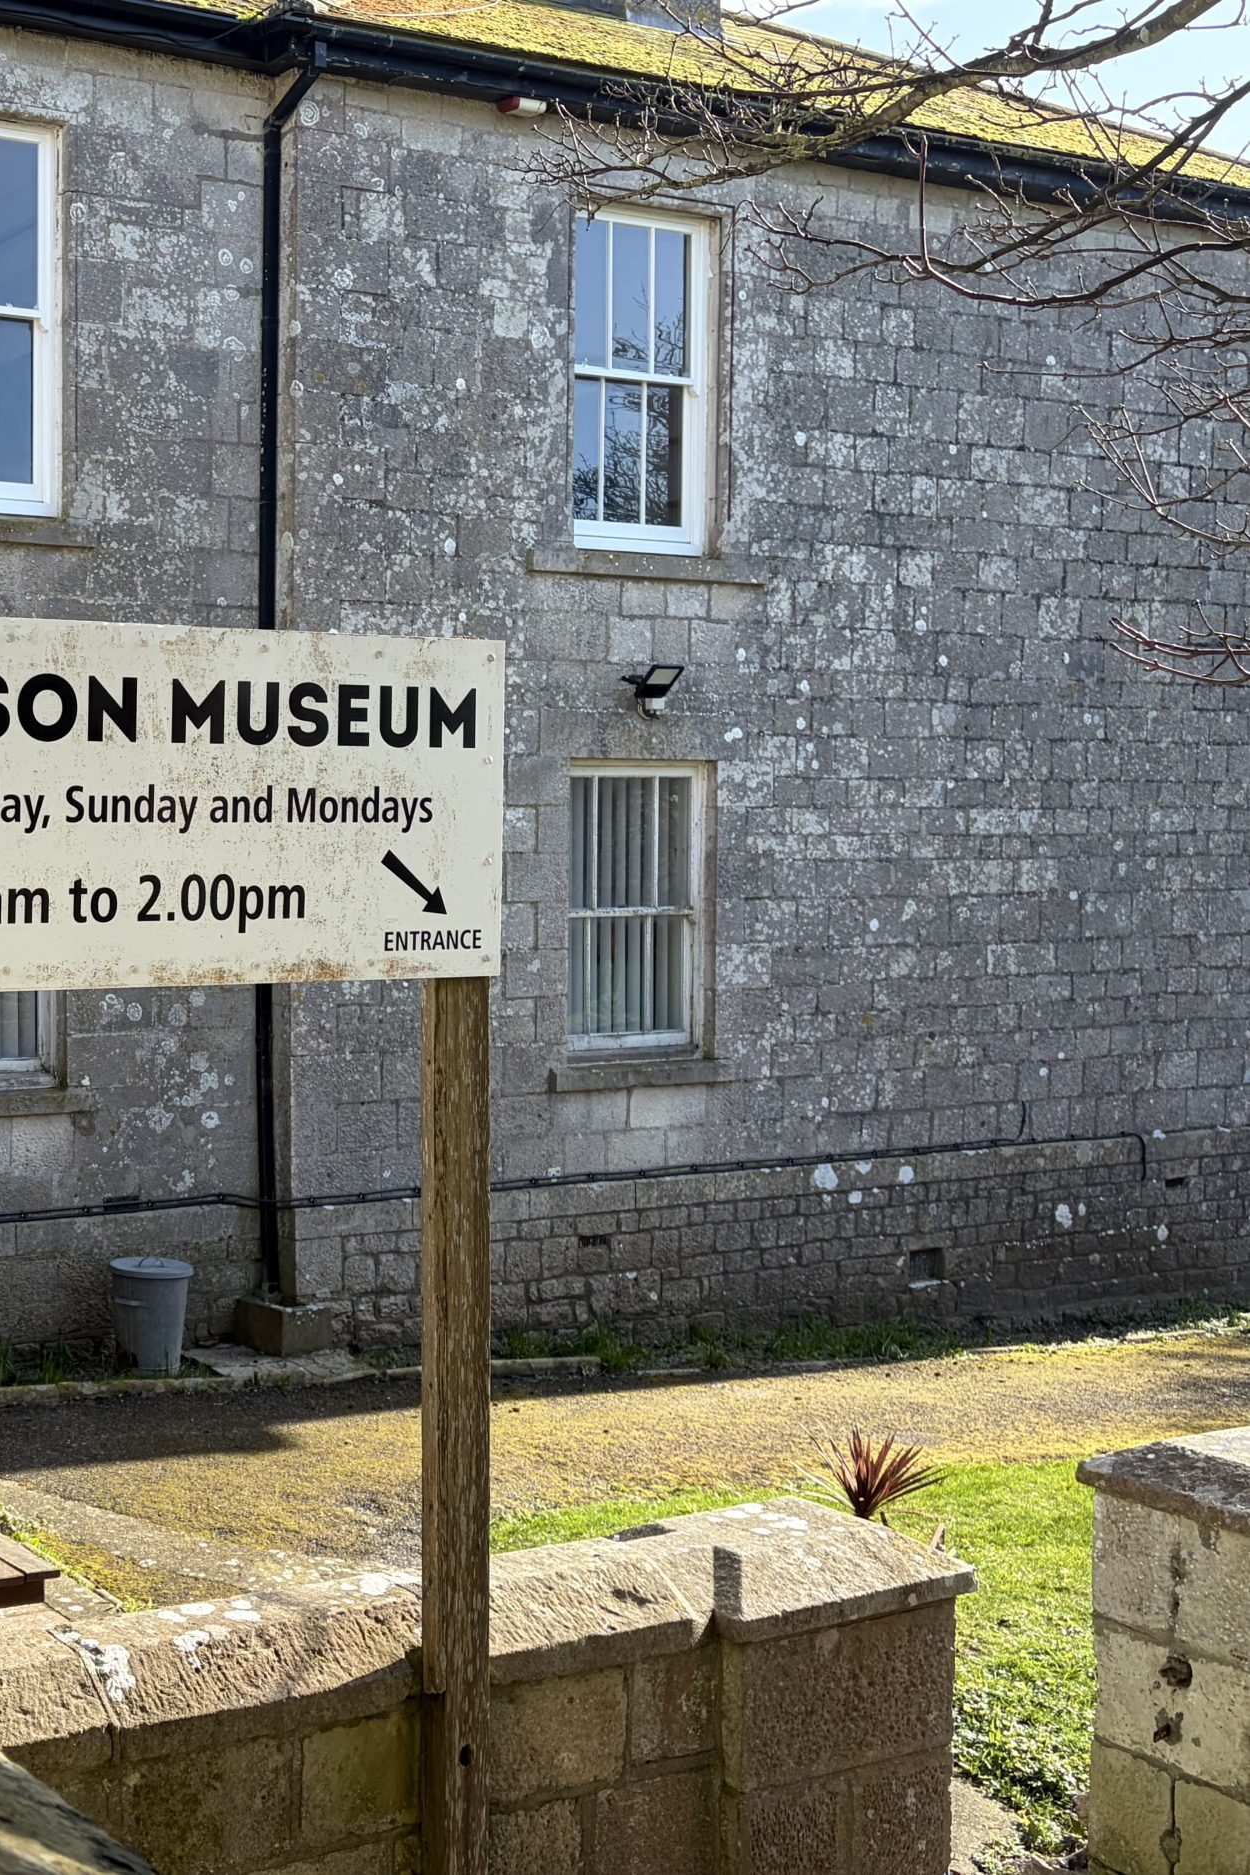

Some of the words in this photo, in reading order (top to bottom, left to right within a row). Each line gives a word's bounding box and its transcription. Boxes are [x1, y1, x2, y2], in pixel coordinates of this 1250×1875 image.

[171, 678, 477, 748] MUSEUM
[65, 784, 198, 833] Sunday
[210, 785, 273, 823] and
[288, 786, 433, 832] Mondays
[69, 879, 118, 924] to
[137, 874, 306, 933] 2.00pm
[384, 930, 482, 951] ENTRANCE
